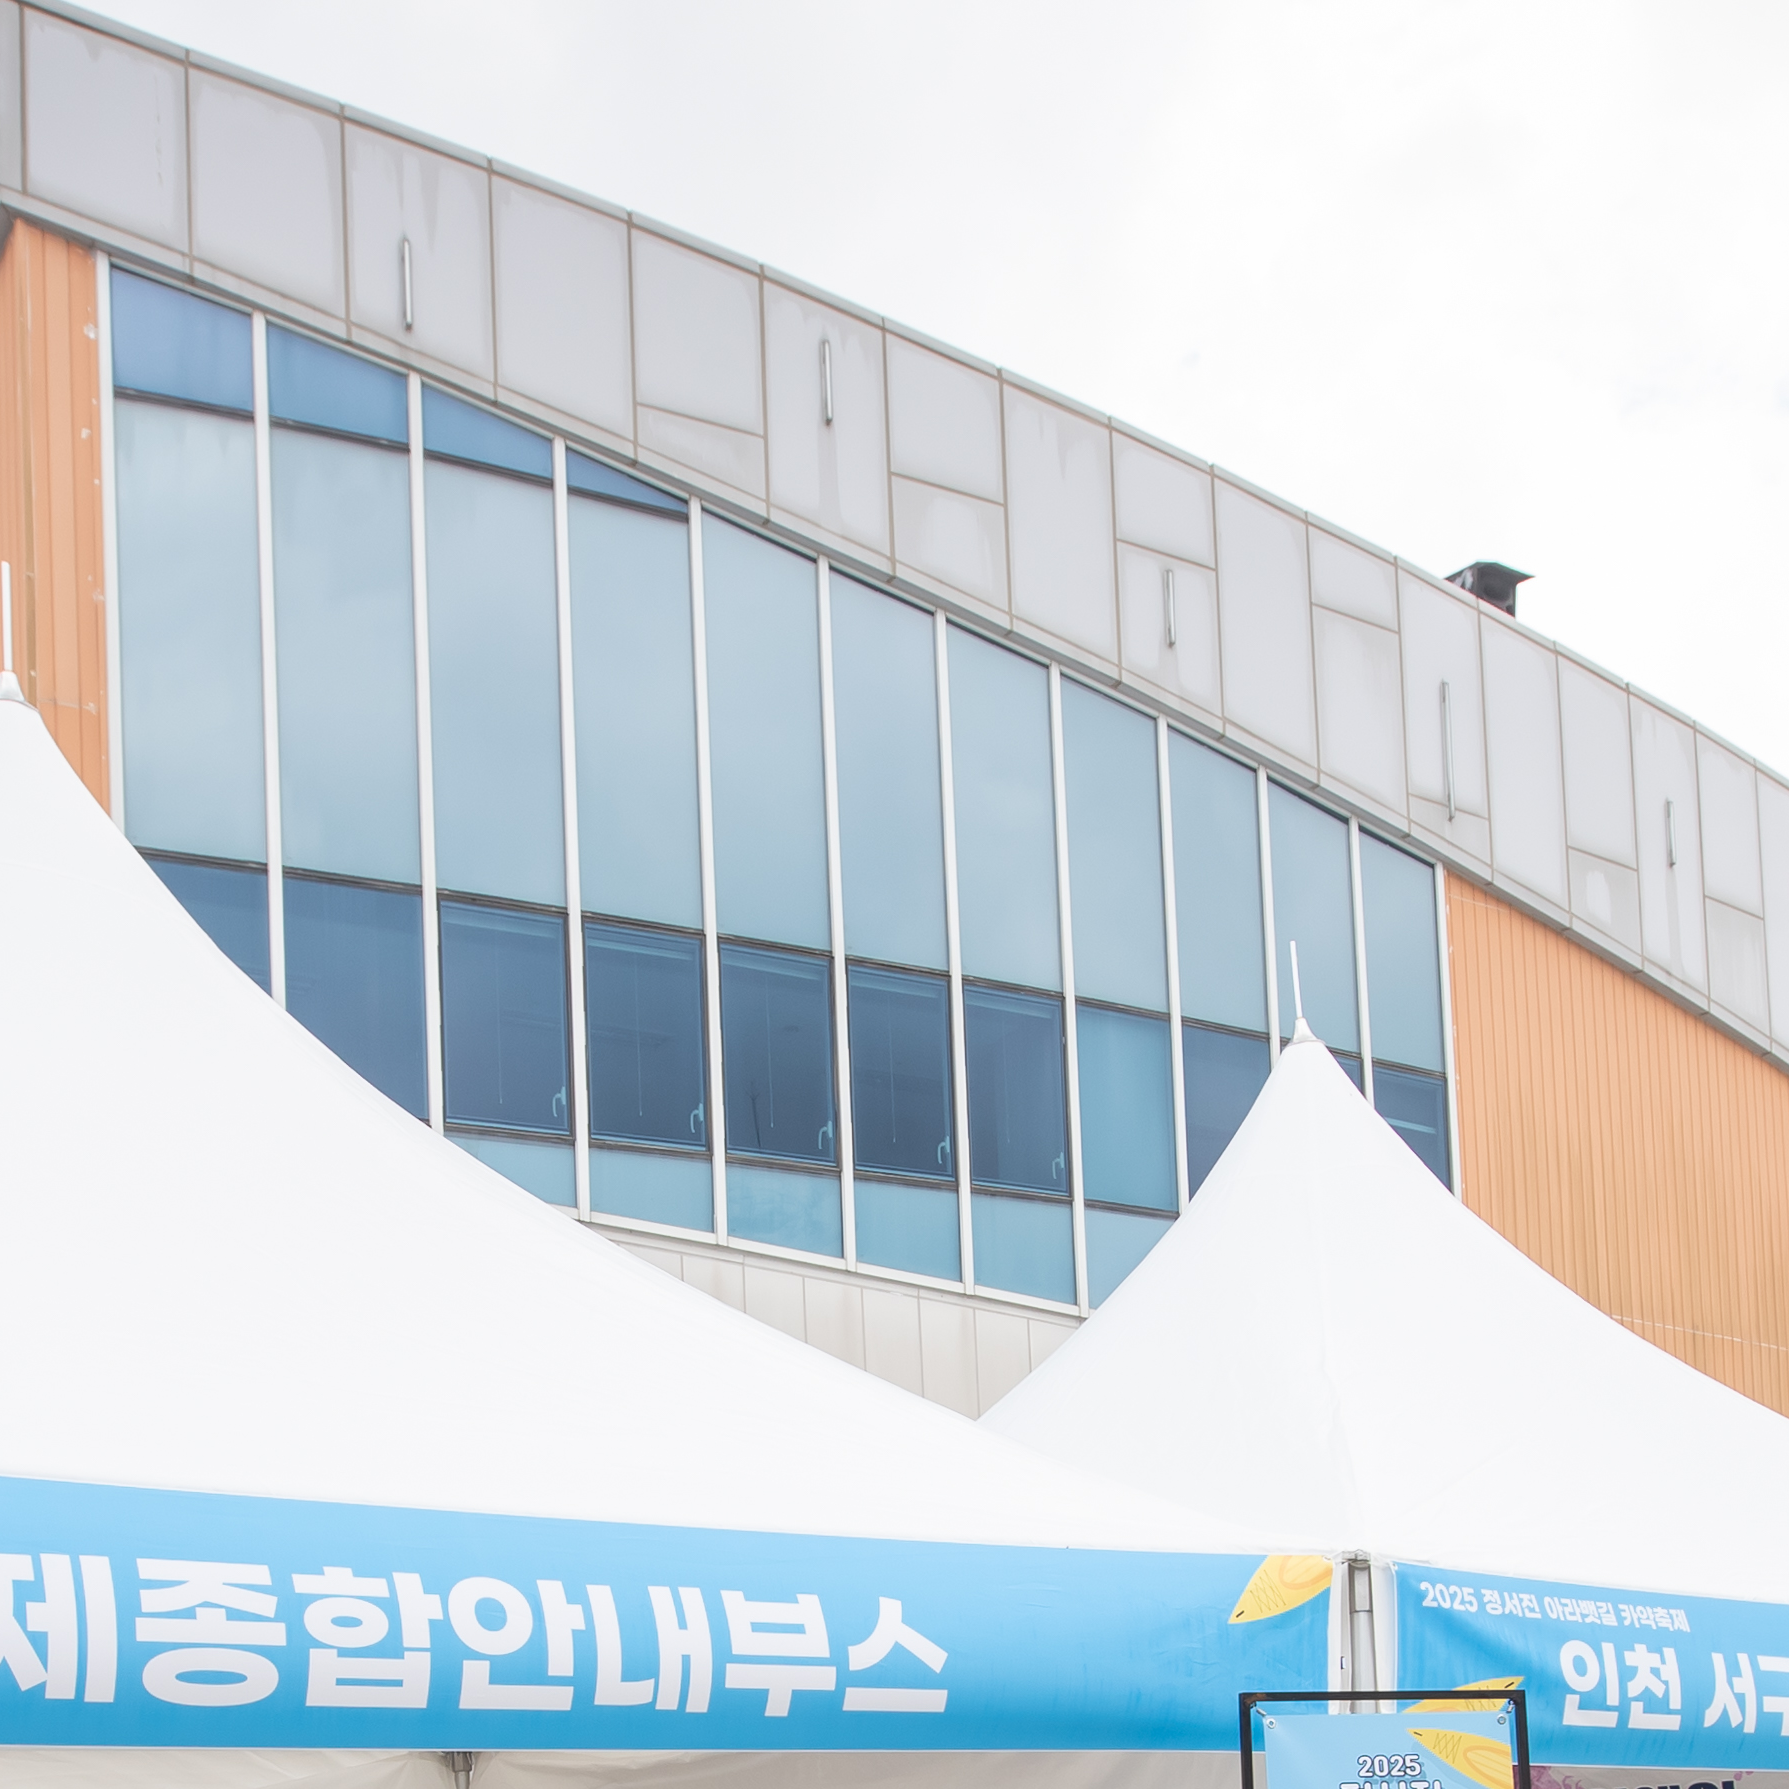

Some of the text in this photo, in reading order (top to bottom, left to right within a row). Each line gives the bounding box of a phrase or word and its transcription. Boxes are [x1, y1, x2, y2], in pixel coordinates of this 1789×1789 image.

[1419, 1581, 1691, 1633] 2025 정서진 아라뱃길 카약축제
[1558, 1640, 1683, 1731] 인천
[1357, 1753, 1422, 1778] 2025
